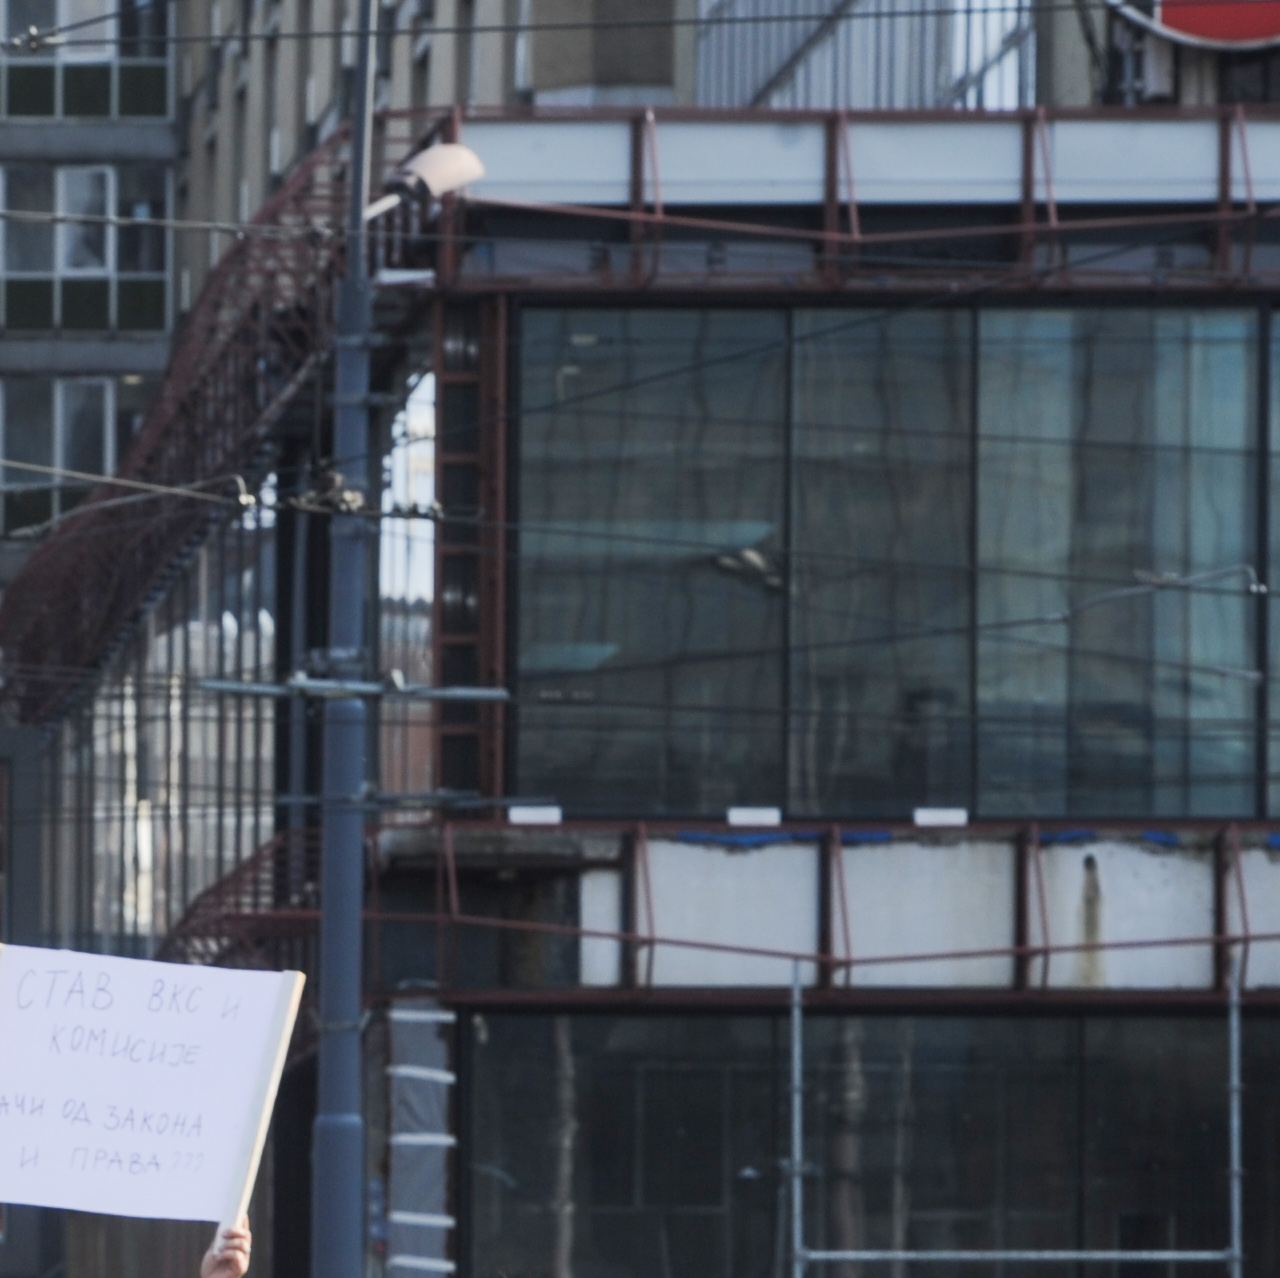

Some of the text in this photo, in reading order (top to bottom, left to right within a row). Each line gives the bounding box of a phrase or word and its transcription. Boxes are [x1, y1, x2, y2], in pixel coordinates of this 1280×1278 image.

[17, 969, 241, 1021] СТАВ ВКС И
[50, 1024, 201, 1068] КОМИСИЈЕ
[62, 1098, 92, 1127] ОД
[102, 1104, 204, 1138] ЗАКОНА
[19, 1145, 40, 1170] И
